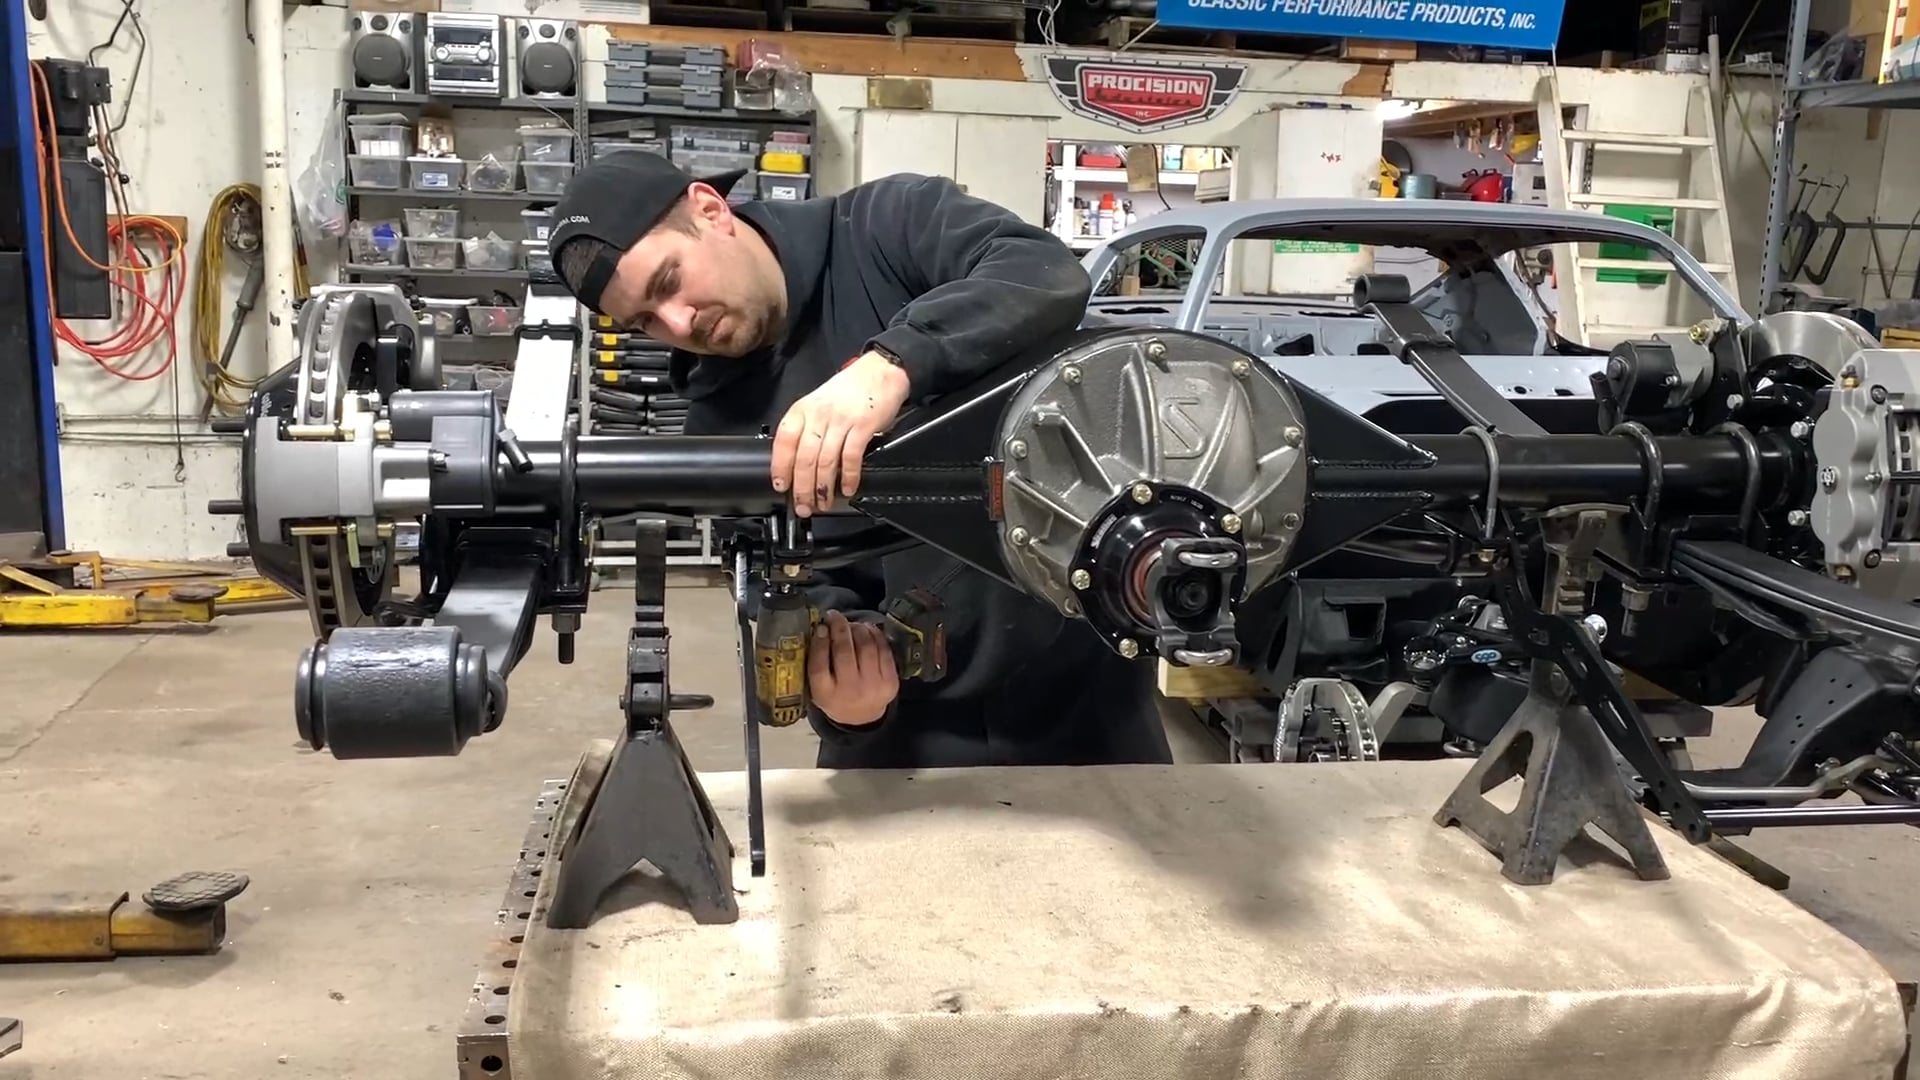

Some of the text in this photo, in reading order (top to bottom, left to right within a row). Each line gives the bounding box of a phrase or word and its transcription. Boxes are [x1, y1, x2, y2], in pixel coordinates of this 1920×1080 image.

[1272, 0, 1410, 21] PERFORMANCE
[1411, 3, 1506, 30] PRODUCTS,
[1508, 13, 1536, 29] INC.
[1088, 74, 1205, 95] PROCISION
